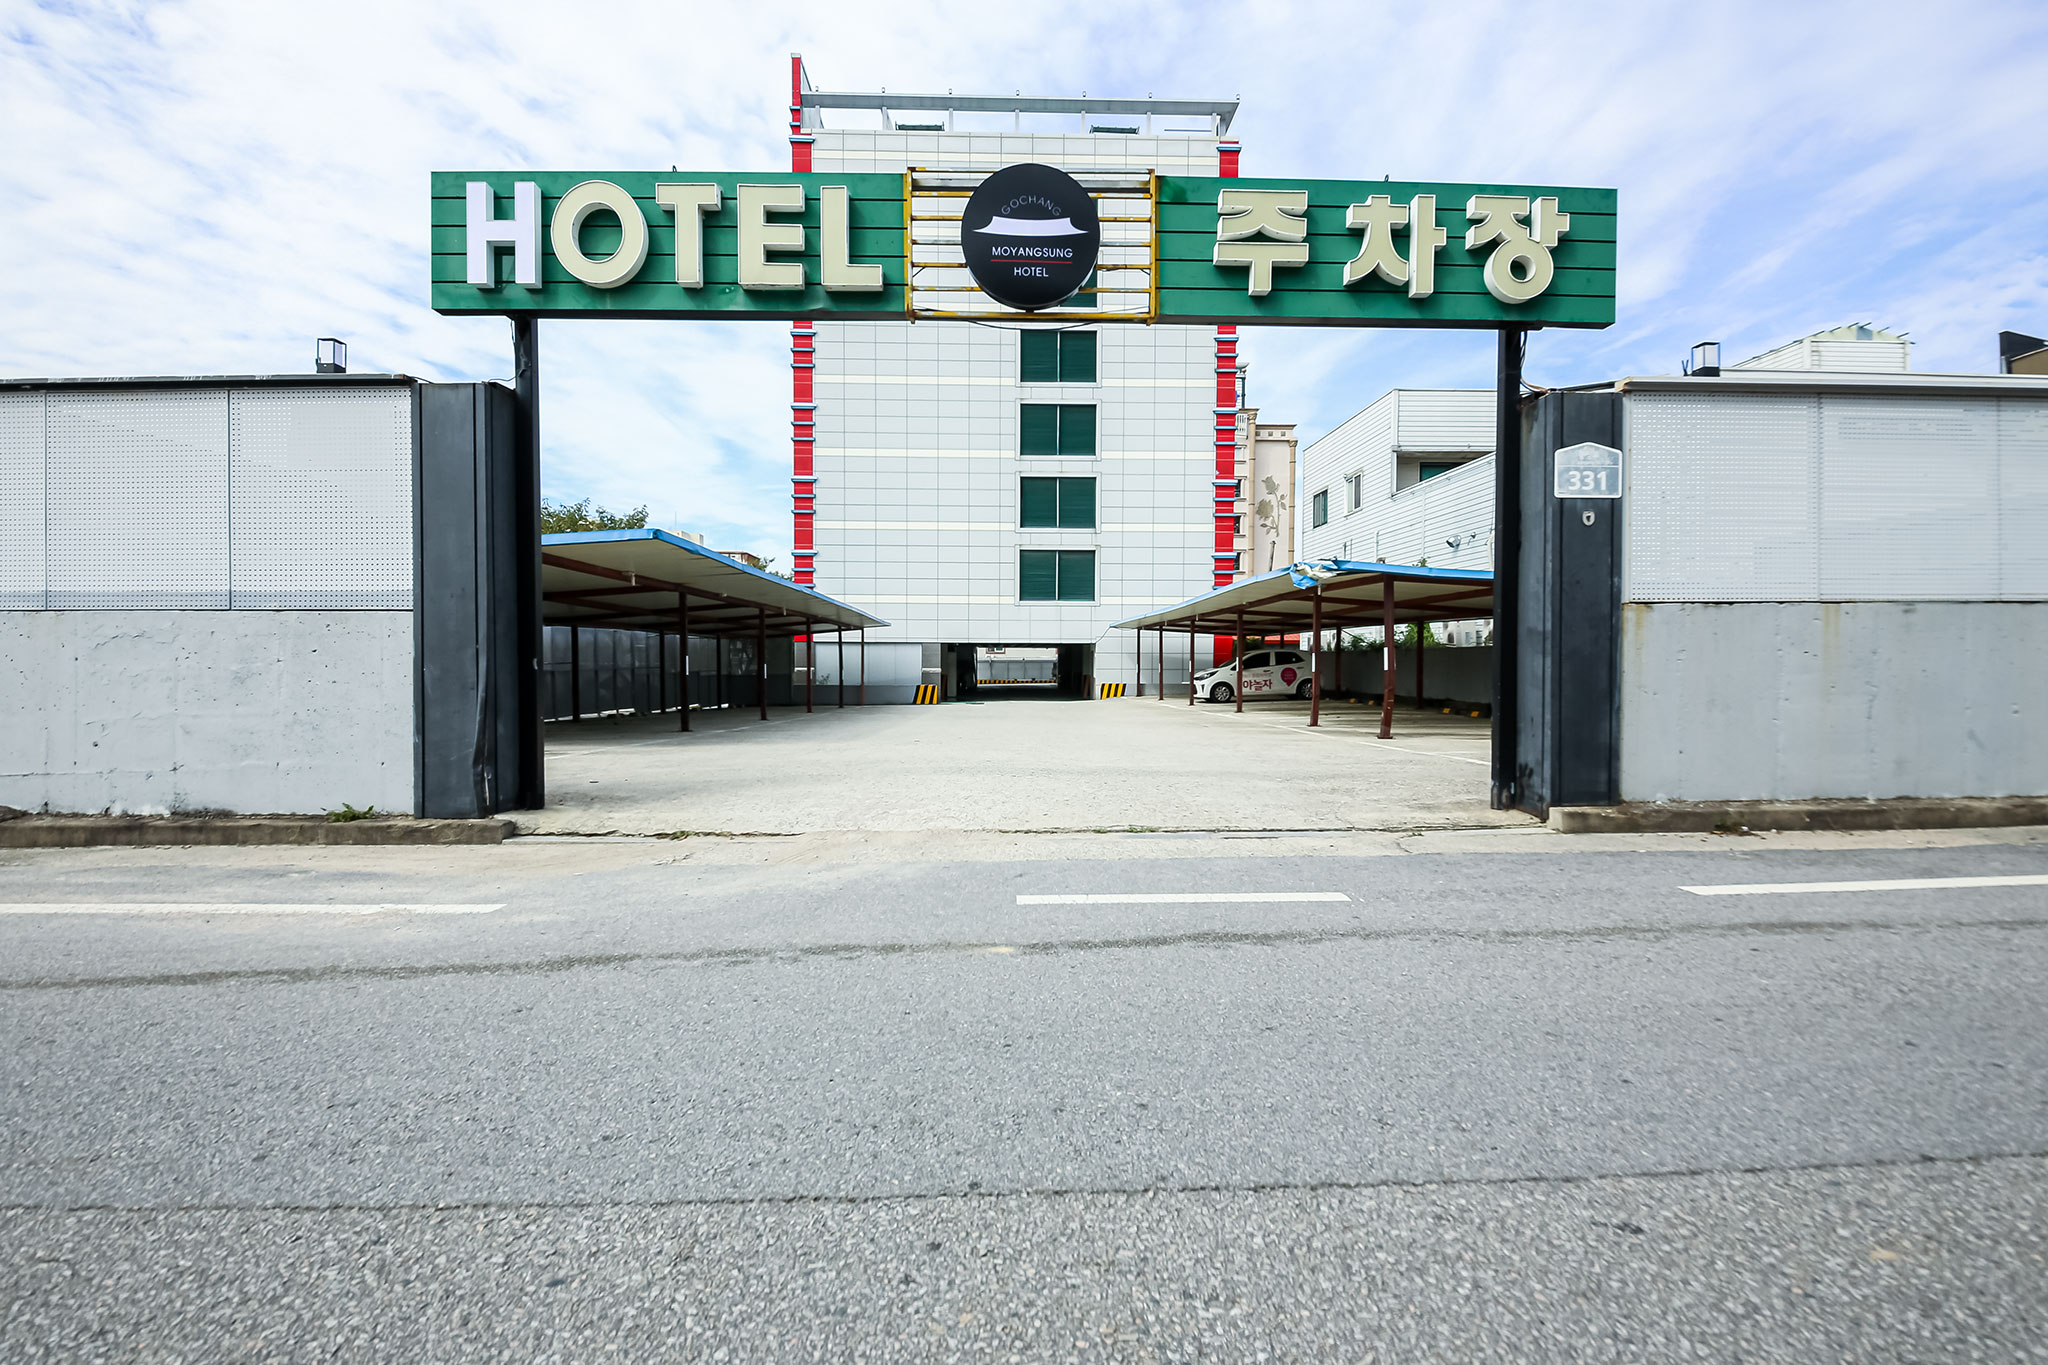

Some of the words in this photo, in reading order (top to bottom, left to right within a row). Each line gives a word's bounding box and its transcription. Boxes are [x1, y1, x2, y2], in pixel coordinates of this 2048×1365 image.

[1001, 195, 1062, 216] GOCHANG
[465, 179, 884, 292] HOTEL
[991, 246, 1073, 258] MOYANGSUNG
[1212, 188, 1570, 305] 주차장
[1013, 266, 1049, 278] HOTEL
[1567, 470, 1607, 491] 331
[1242, 678, 1273, 691] 야놀자
